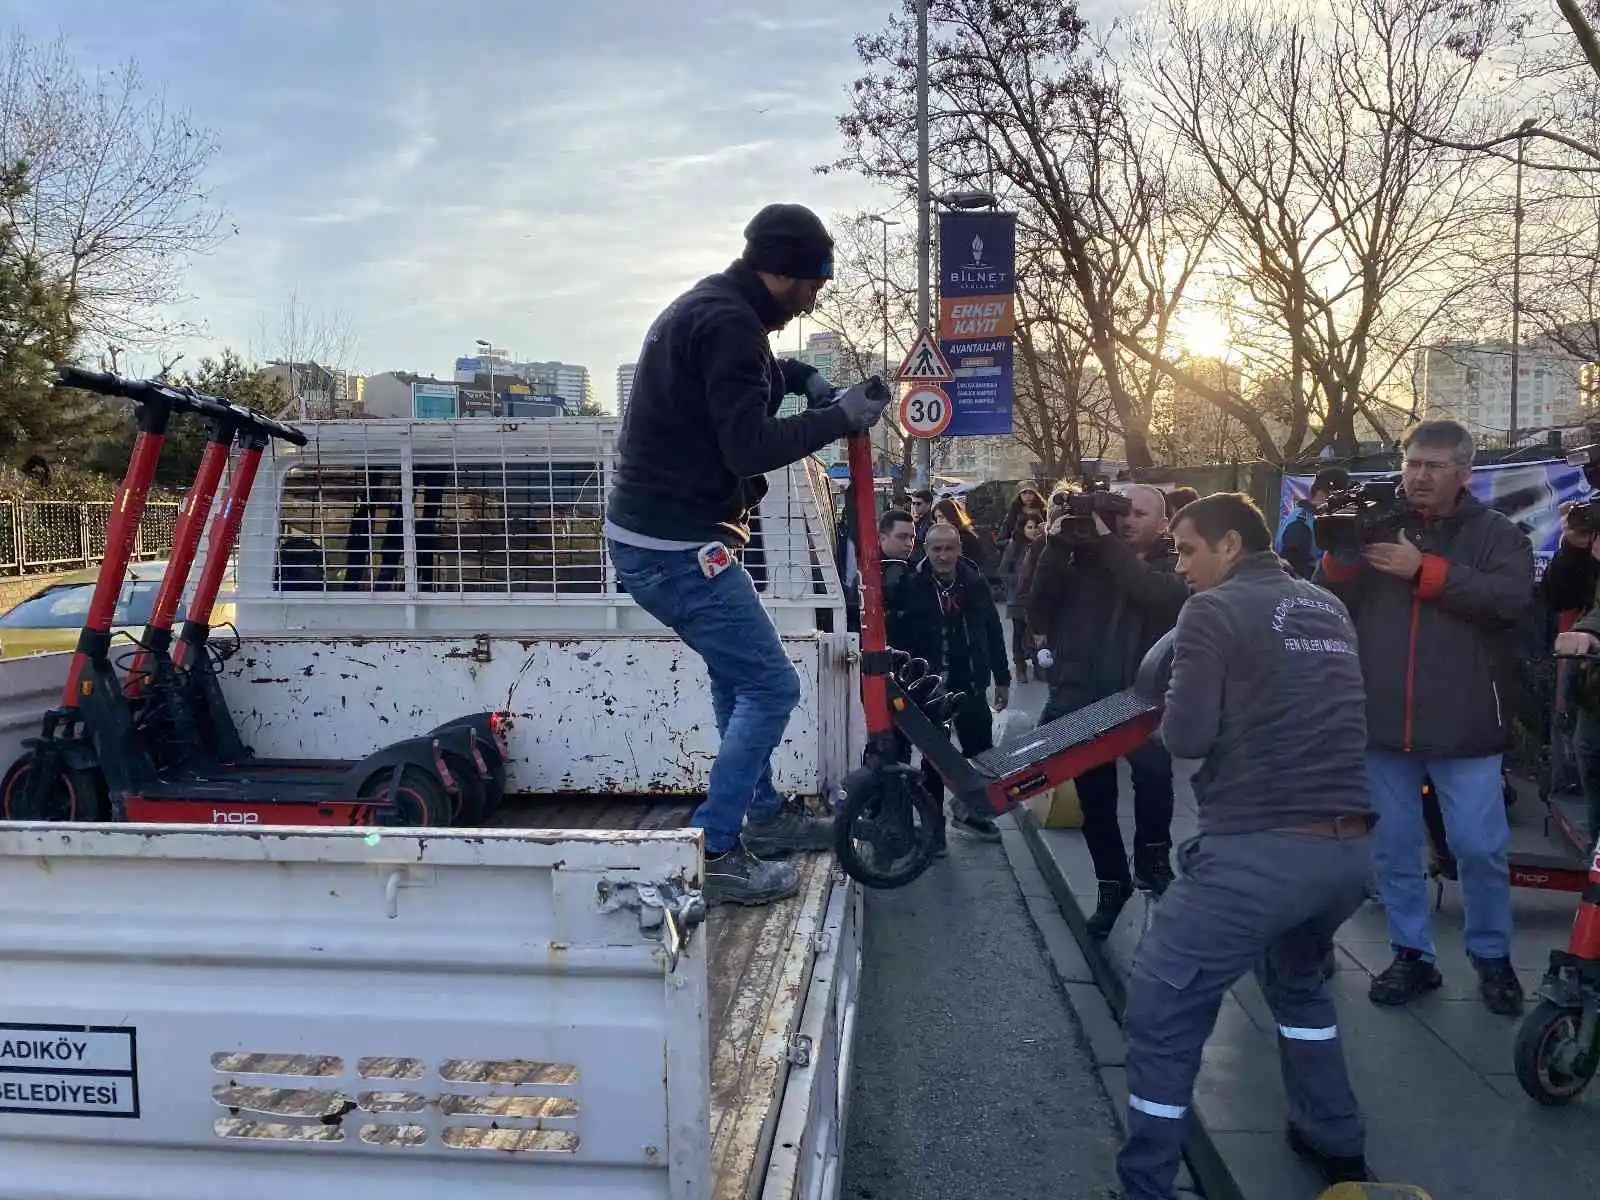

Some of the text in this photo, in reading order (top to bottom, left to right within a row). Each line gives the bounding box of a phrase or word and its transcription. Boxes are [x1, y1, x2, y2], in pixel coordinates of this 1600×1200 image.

[950, 302, 1007, 318] ERKEN
[954, 319, 999, 334] KAYIT
[949, 341, 1006, 354] AVANTAJLARI
[910, 399, 941, 423] 30
[212, 809, 259, 825] hop
[1515, 872, 1550, 883] hop
[0, 1080, 118, 1105] ELEDİYESİ
